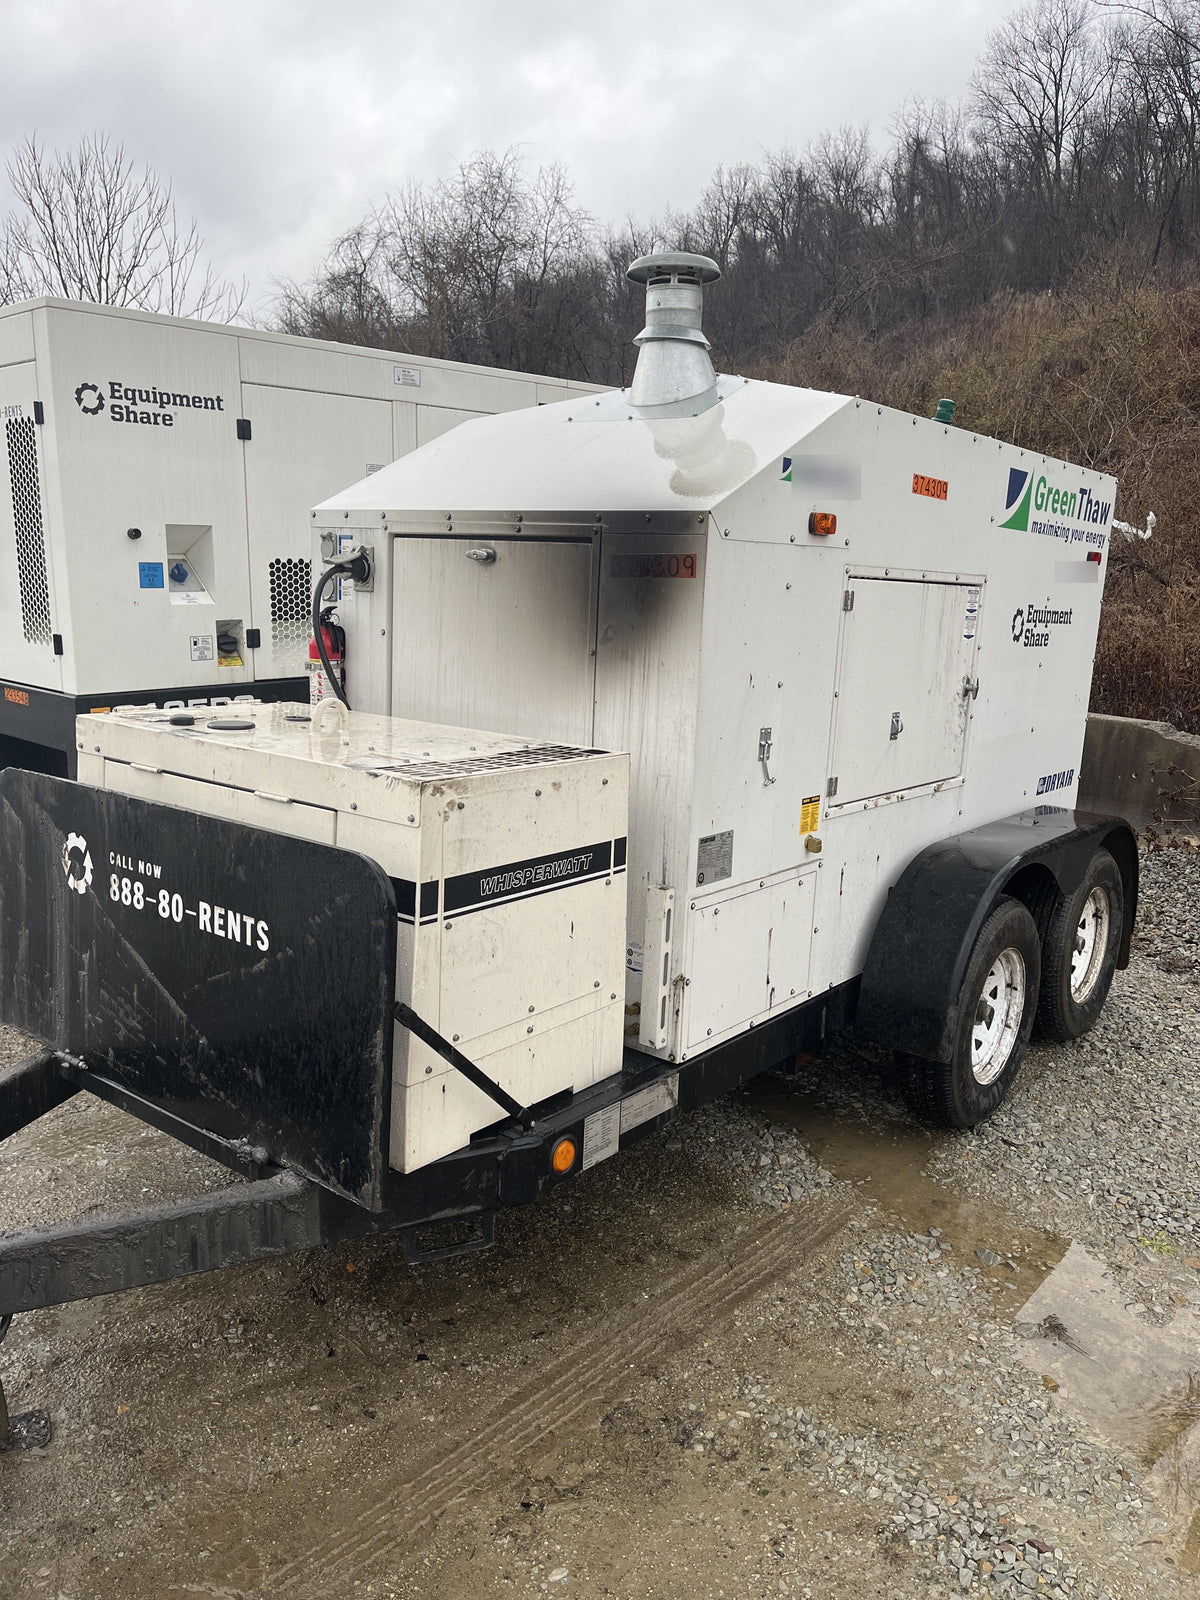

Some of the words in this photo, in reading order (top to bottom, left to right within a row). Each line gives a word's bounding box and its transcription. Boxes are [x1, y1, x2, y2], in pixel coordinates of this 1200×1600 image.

[109, 381, 224, 411] Equipment
[110, 403, 174, 427] Share
[913, 475, 948, 500] 374309
[1031, 520, 1069, 543] maximizing
[1070, 530, 1085, 544] your
[1086, 532, 1106, 549] energy
[1026, 604, 1073, 628] Equipment
[1023, 628, 1049, 647] Share
[1045, 769, 1074, 793] DRYAIR
[109, 851, 134, 871] CALL
[138, 860, 162, 879] NOW
[480, 853, 593, 896] WHISPERWATT
[110, 873, 269, 951] 888-80-RENTS
